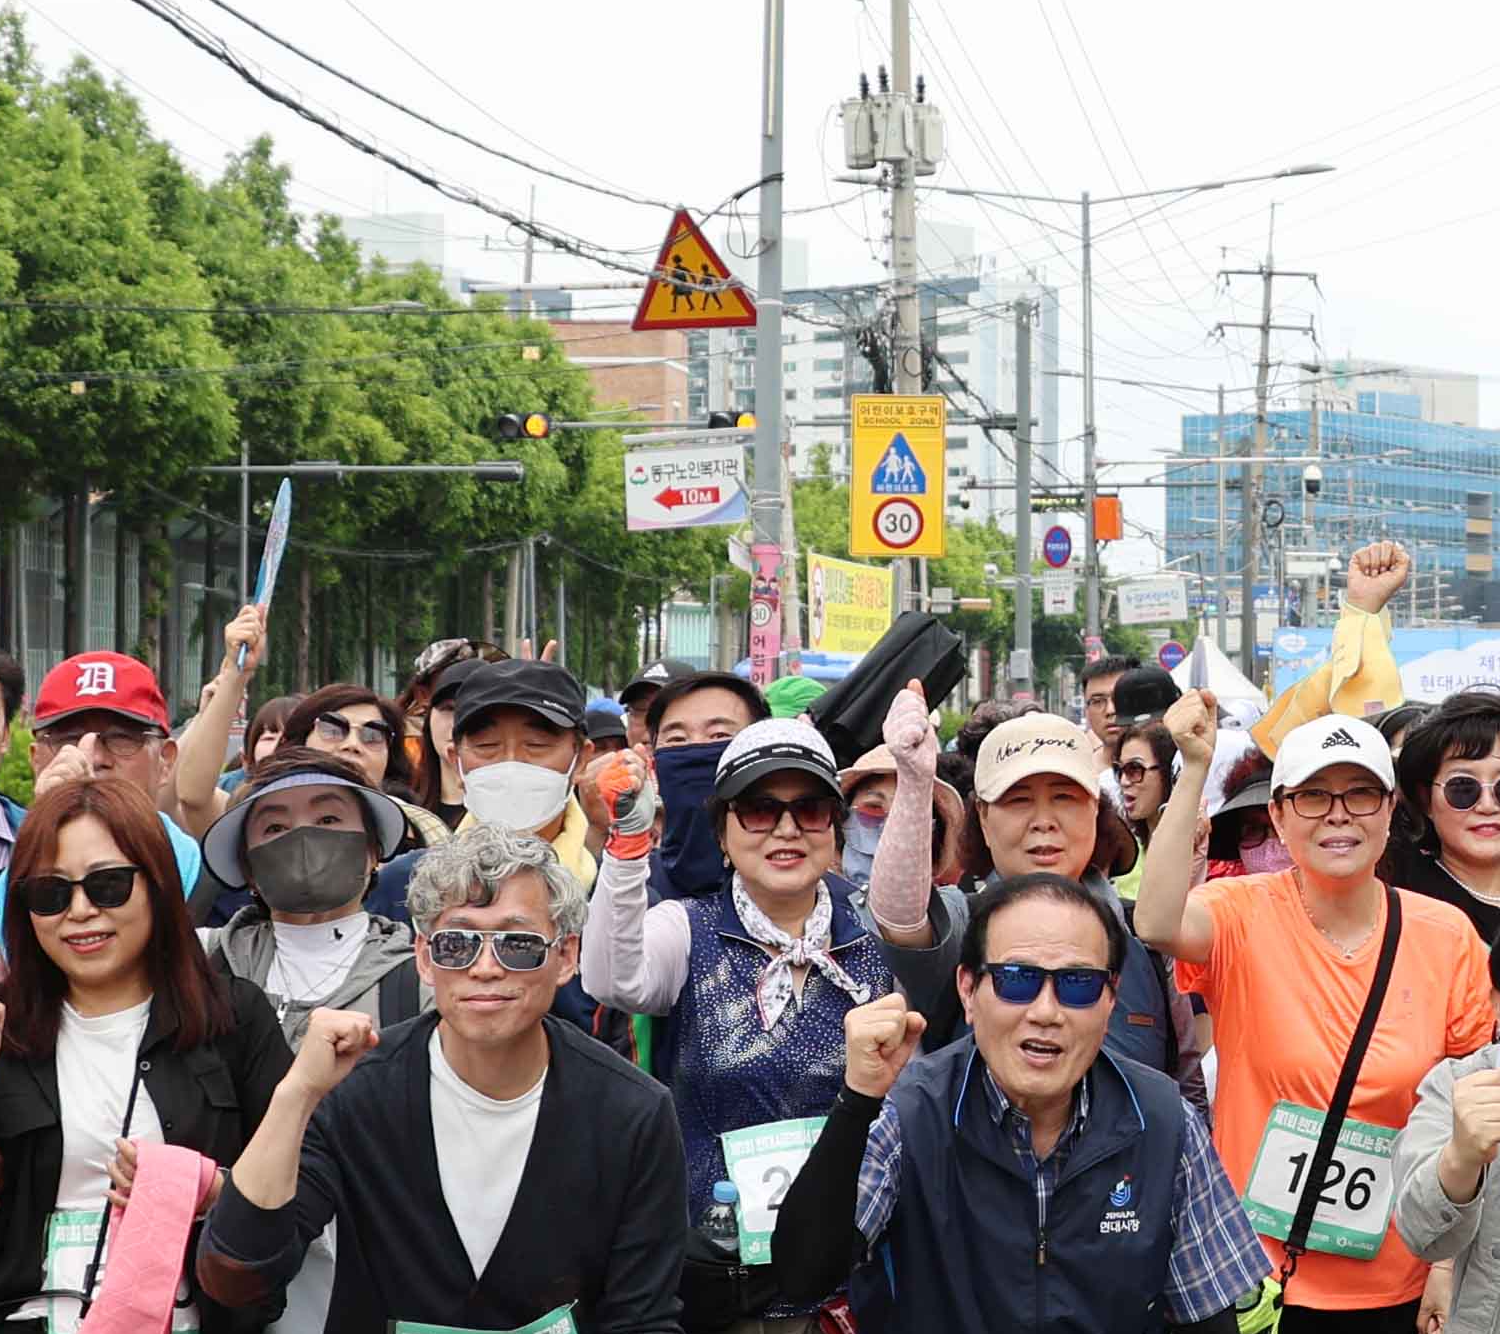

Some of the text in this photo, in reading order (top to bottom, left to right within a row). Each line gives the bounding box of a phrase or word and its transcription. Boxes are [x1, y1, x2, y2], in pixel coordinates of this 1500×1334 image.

[859, 404, 939, 417] 어린이보호구역
[651, 458, 739, 484] 동구노인복지관
[681, 489, 713, 505] 10M
[884, 513, 912, 534] 30
[1288, 1151, 1376, 1212] 126
